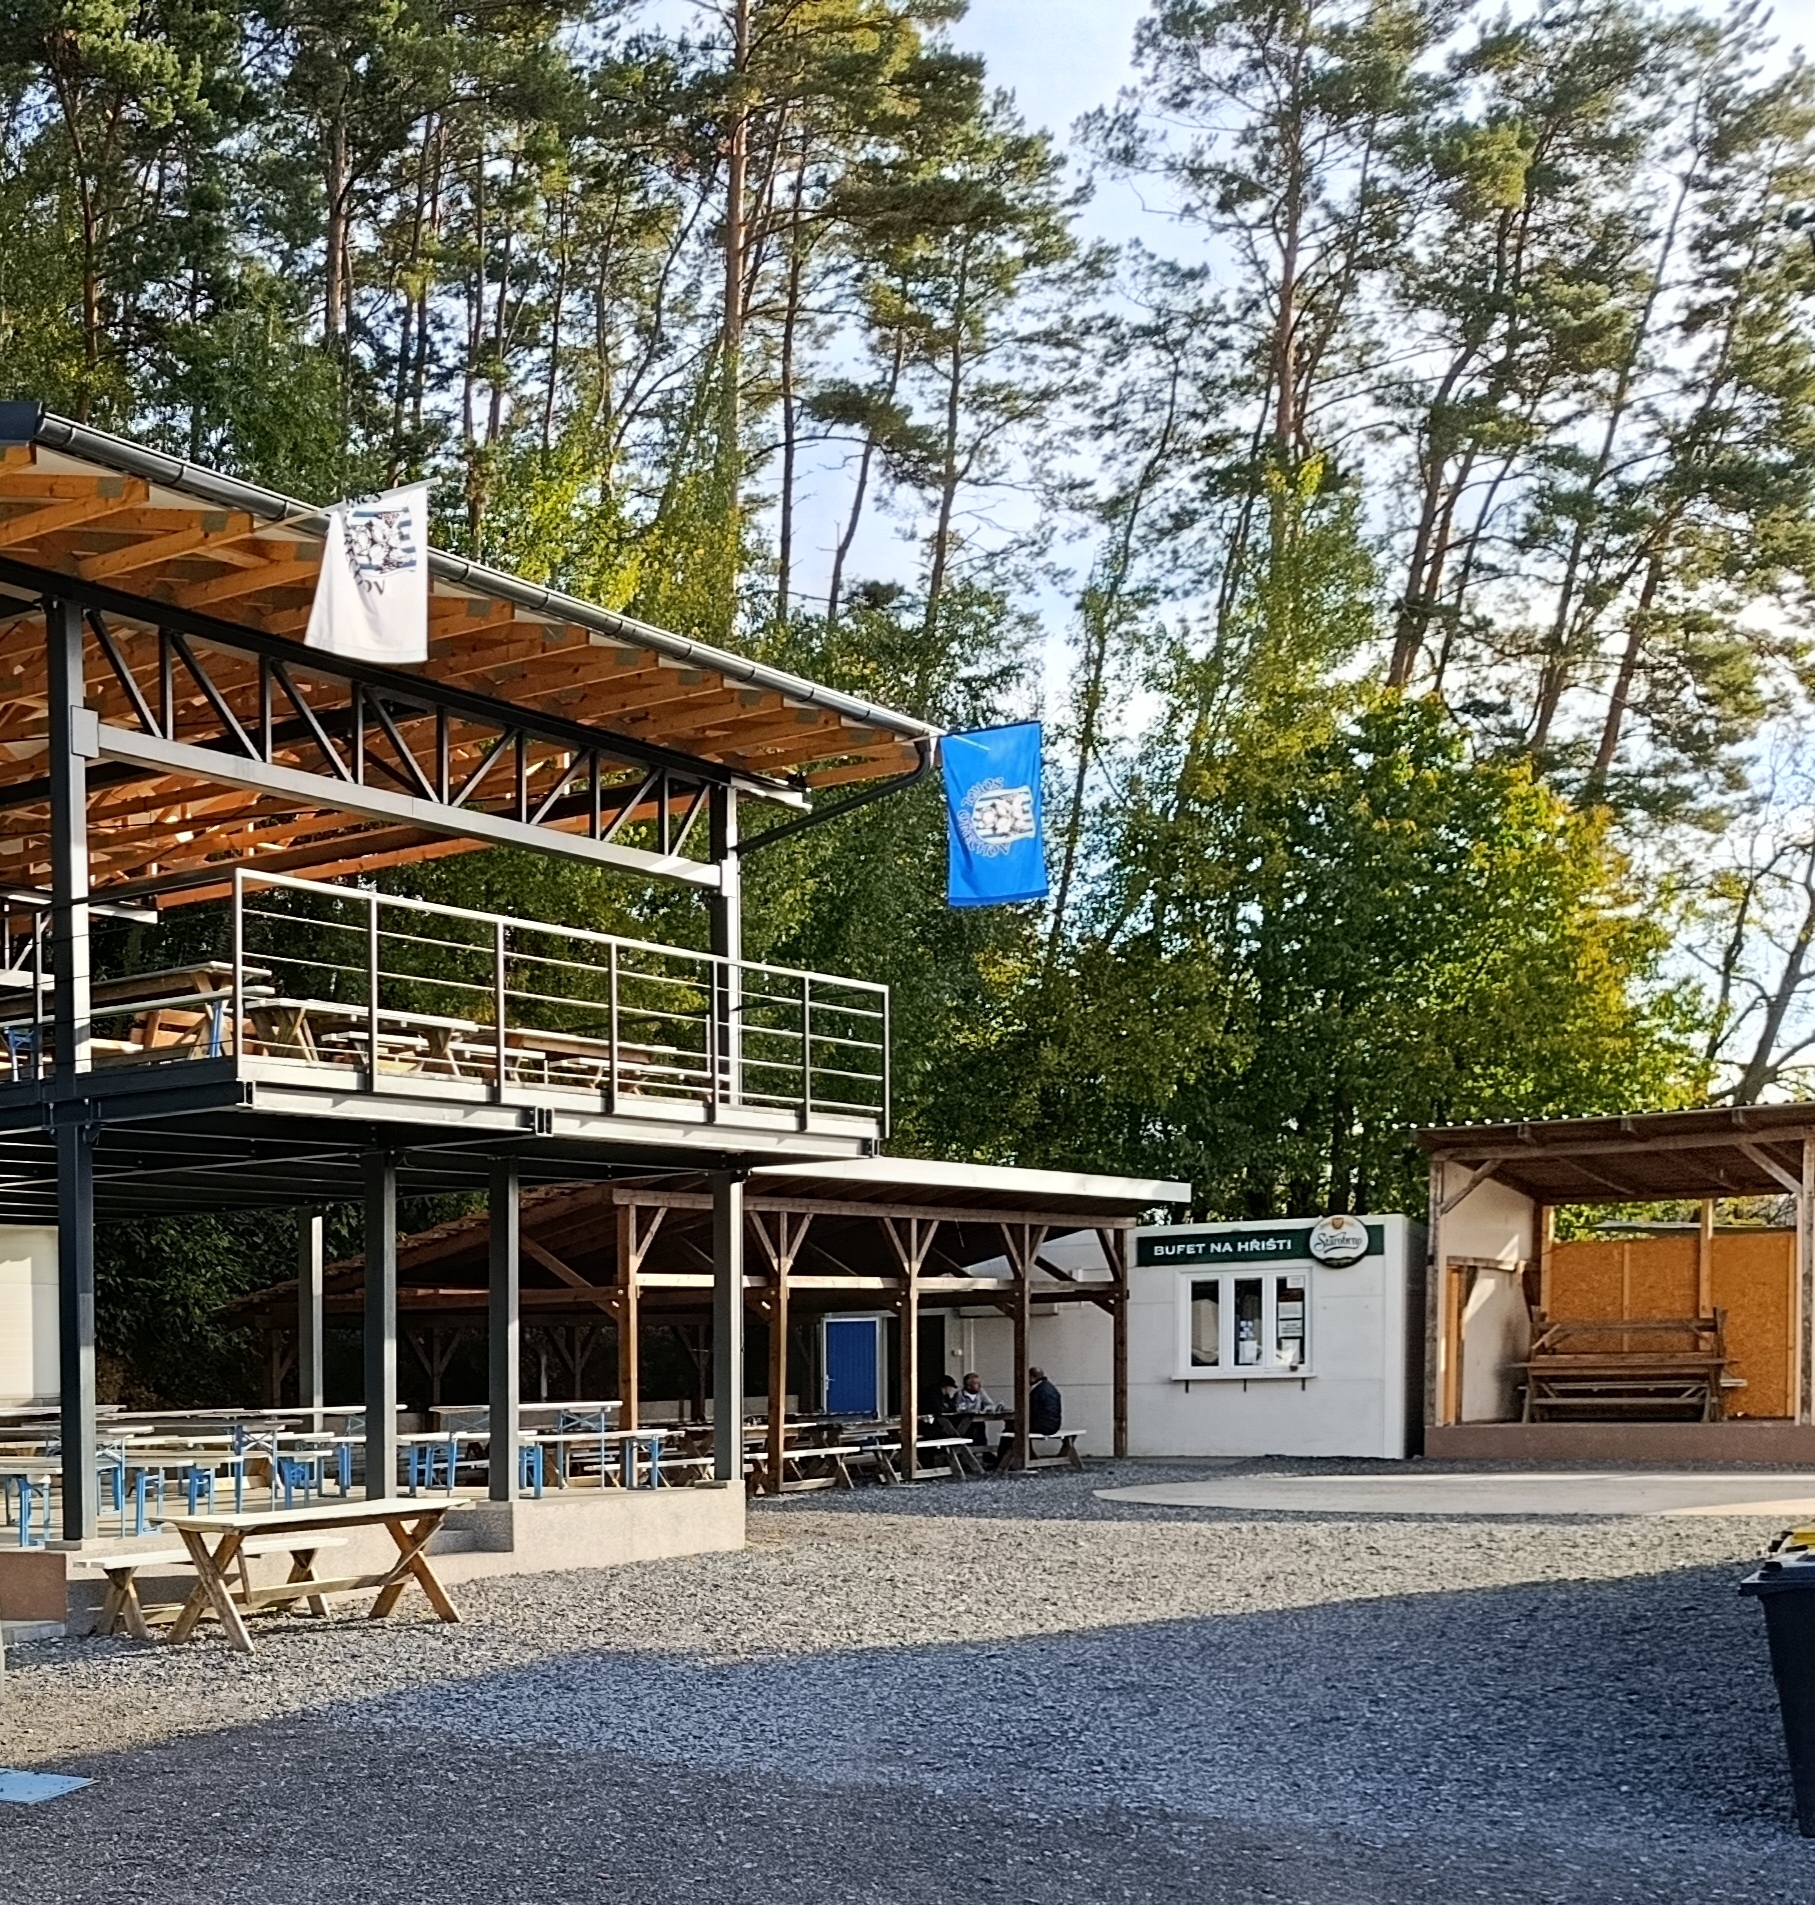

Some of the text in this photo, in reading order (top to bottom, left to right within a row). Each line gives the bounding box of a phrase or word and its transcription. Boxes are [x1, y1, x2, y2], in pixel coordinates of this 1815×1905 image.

[1153, 1238, 1292, 1256] BUFET NA HŘIŠTI
